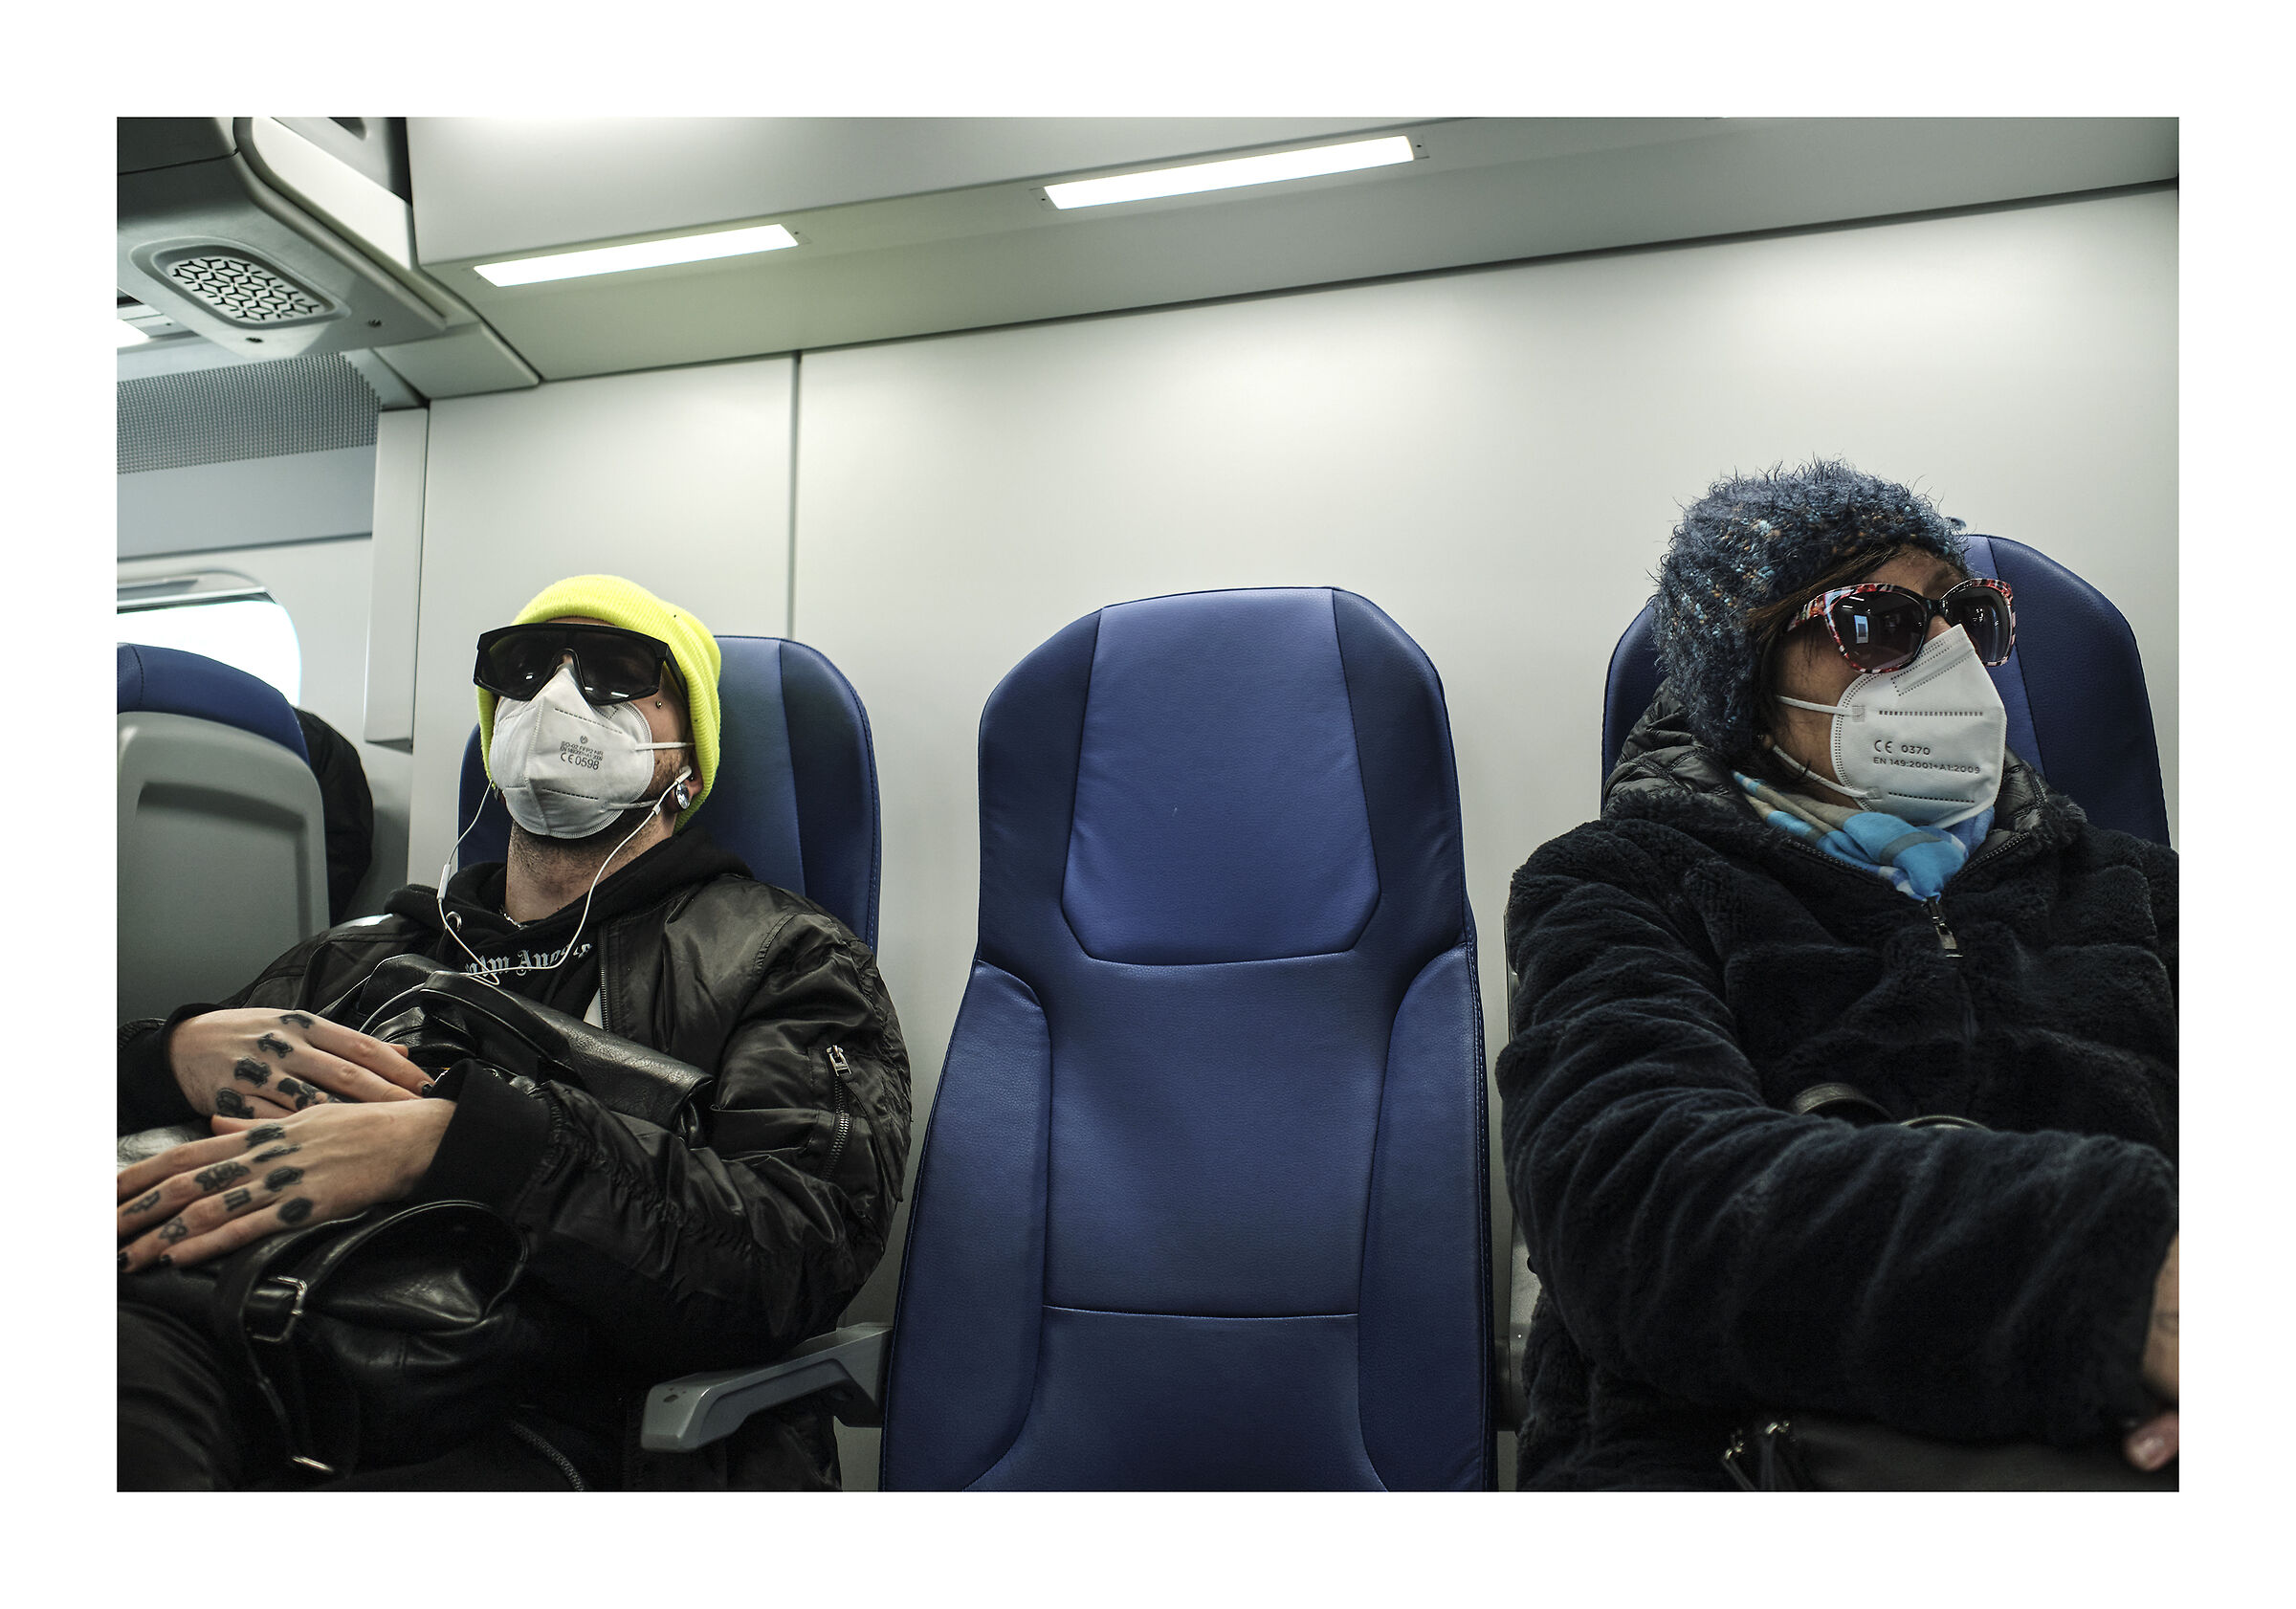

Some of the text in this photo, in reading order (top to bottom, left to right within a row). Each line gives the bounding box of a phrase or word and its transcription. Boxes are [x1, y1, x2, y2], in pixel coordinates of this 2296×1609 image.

[1874, 739, 1931, 756] CE 0370
[560, 752, 599, 770] CE 0598
[1873, 757, 1981, 774] EN 149:2001+A1:2009
[464, 955, 511, 977] alm
